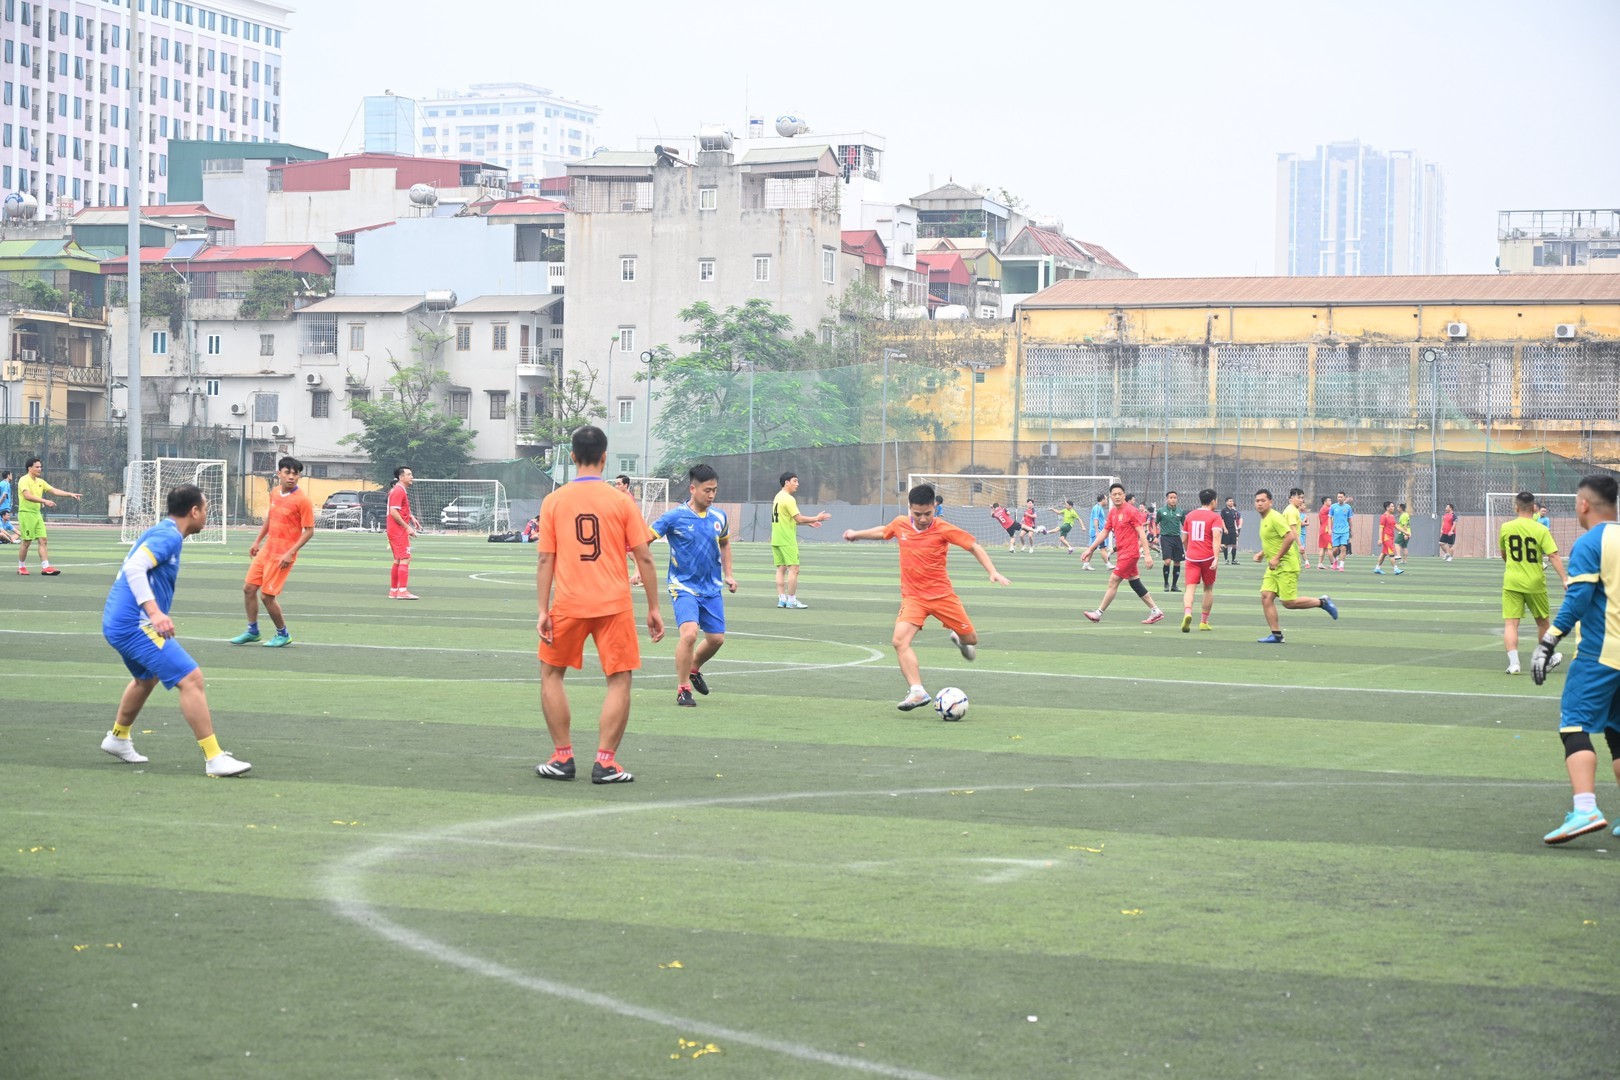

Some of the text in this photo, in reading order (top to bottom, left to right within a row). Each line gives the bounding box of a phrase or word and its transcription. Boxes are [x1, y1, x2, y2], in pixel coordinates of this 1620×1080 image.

[575, 513, 601, 561] 9
[1191, 520, 1206, 542] 10
[1509, 534, 1538, 564] 86
